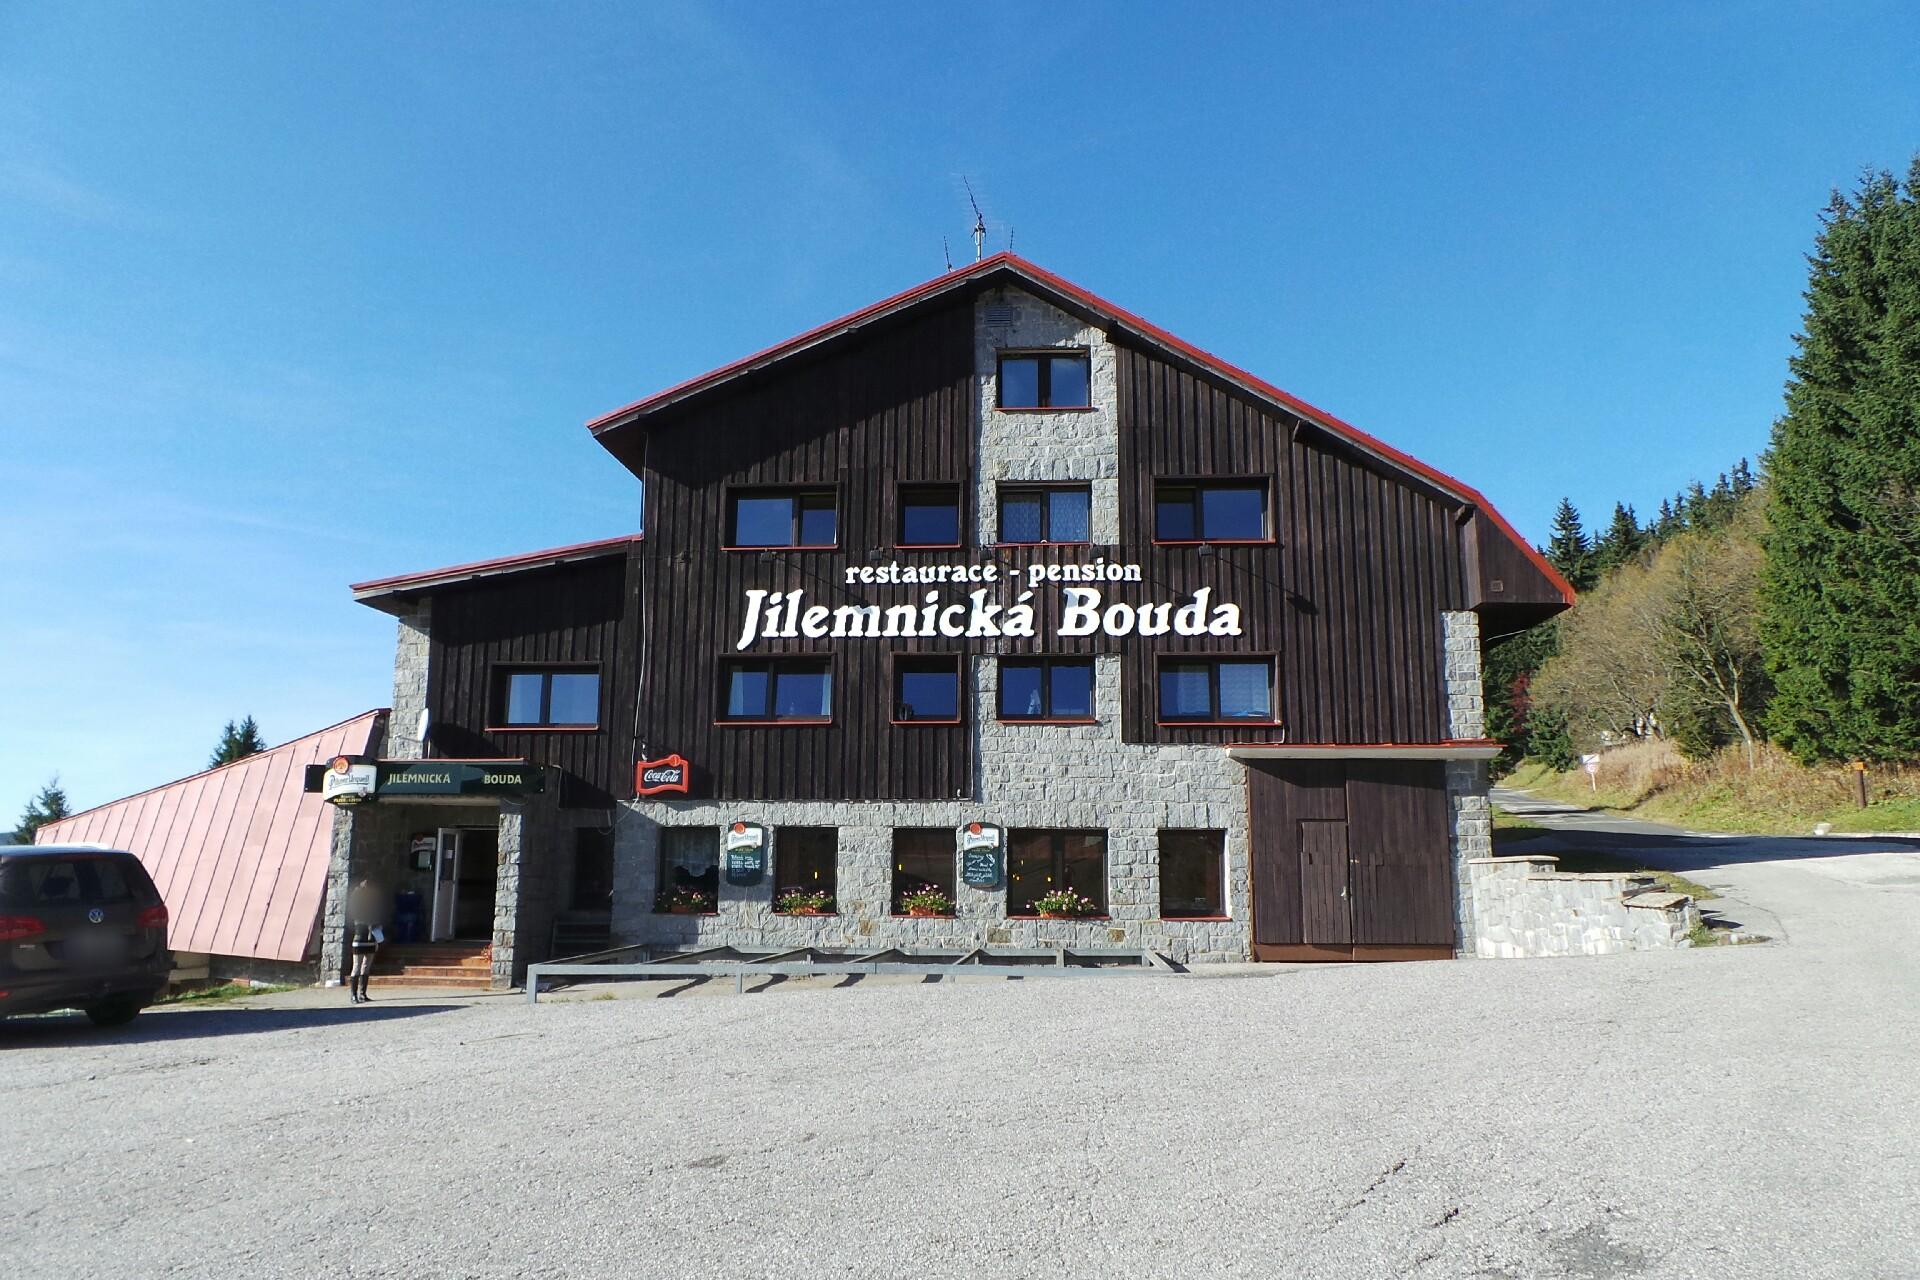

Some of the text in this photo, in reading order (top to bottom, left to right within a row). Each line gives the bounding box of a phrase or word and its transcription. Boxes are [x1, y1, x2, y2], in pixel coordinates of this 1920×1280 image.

[845, 560, 998, 584] restaurace
[1027, 557, 1143, 588] pension
[736, 585, 1243, 651] Jilemnická Bouda
[387, 772, 522, 785] JILEMNICKÁ BOUDA
